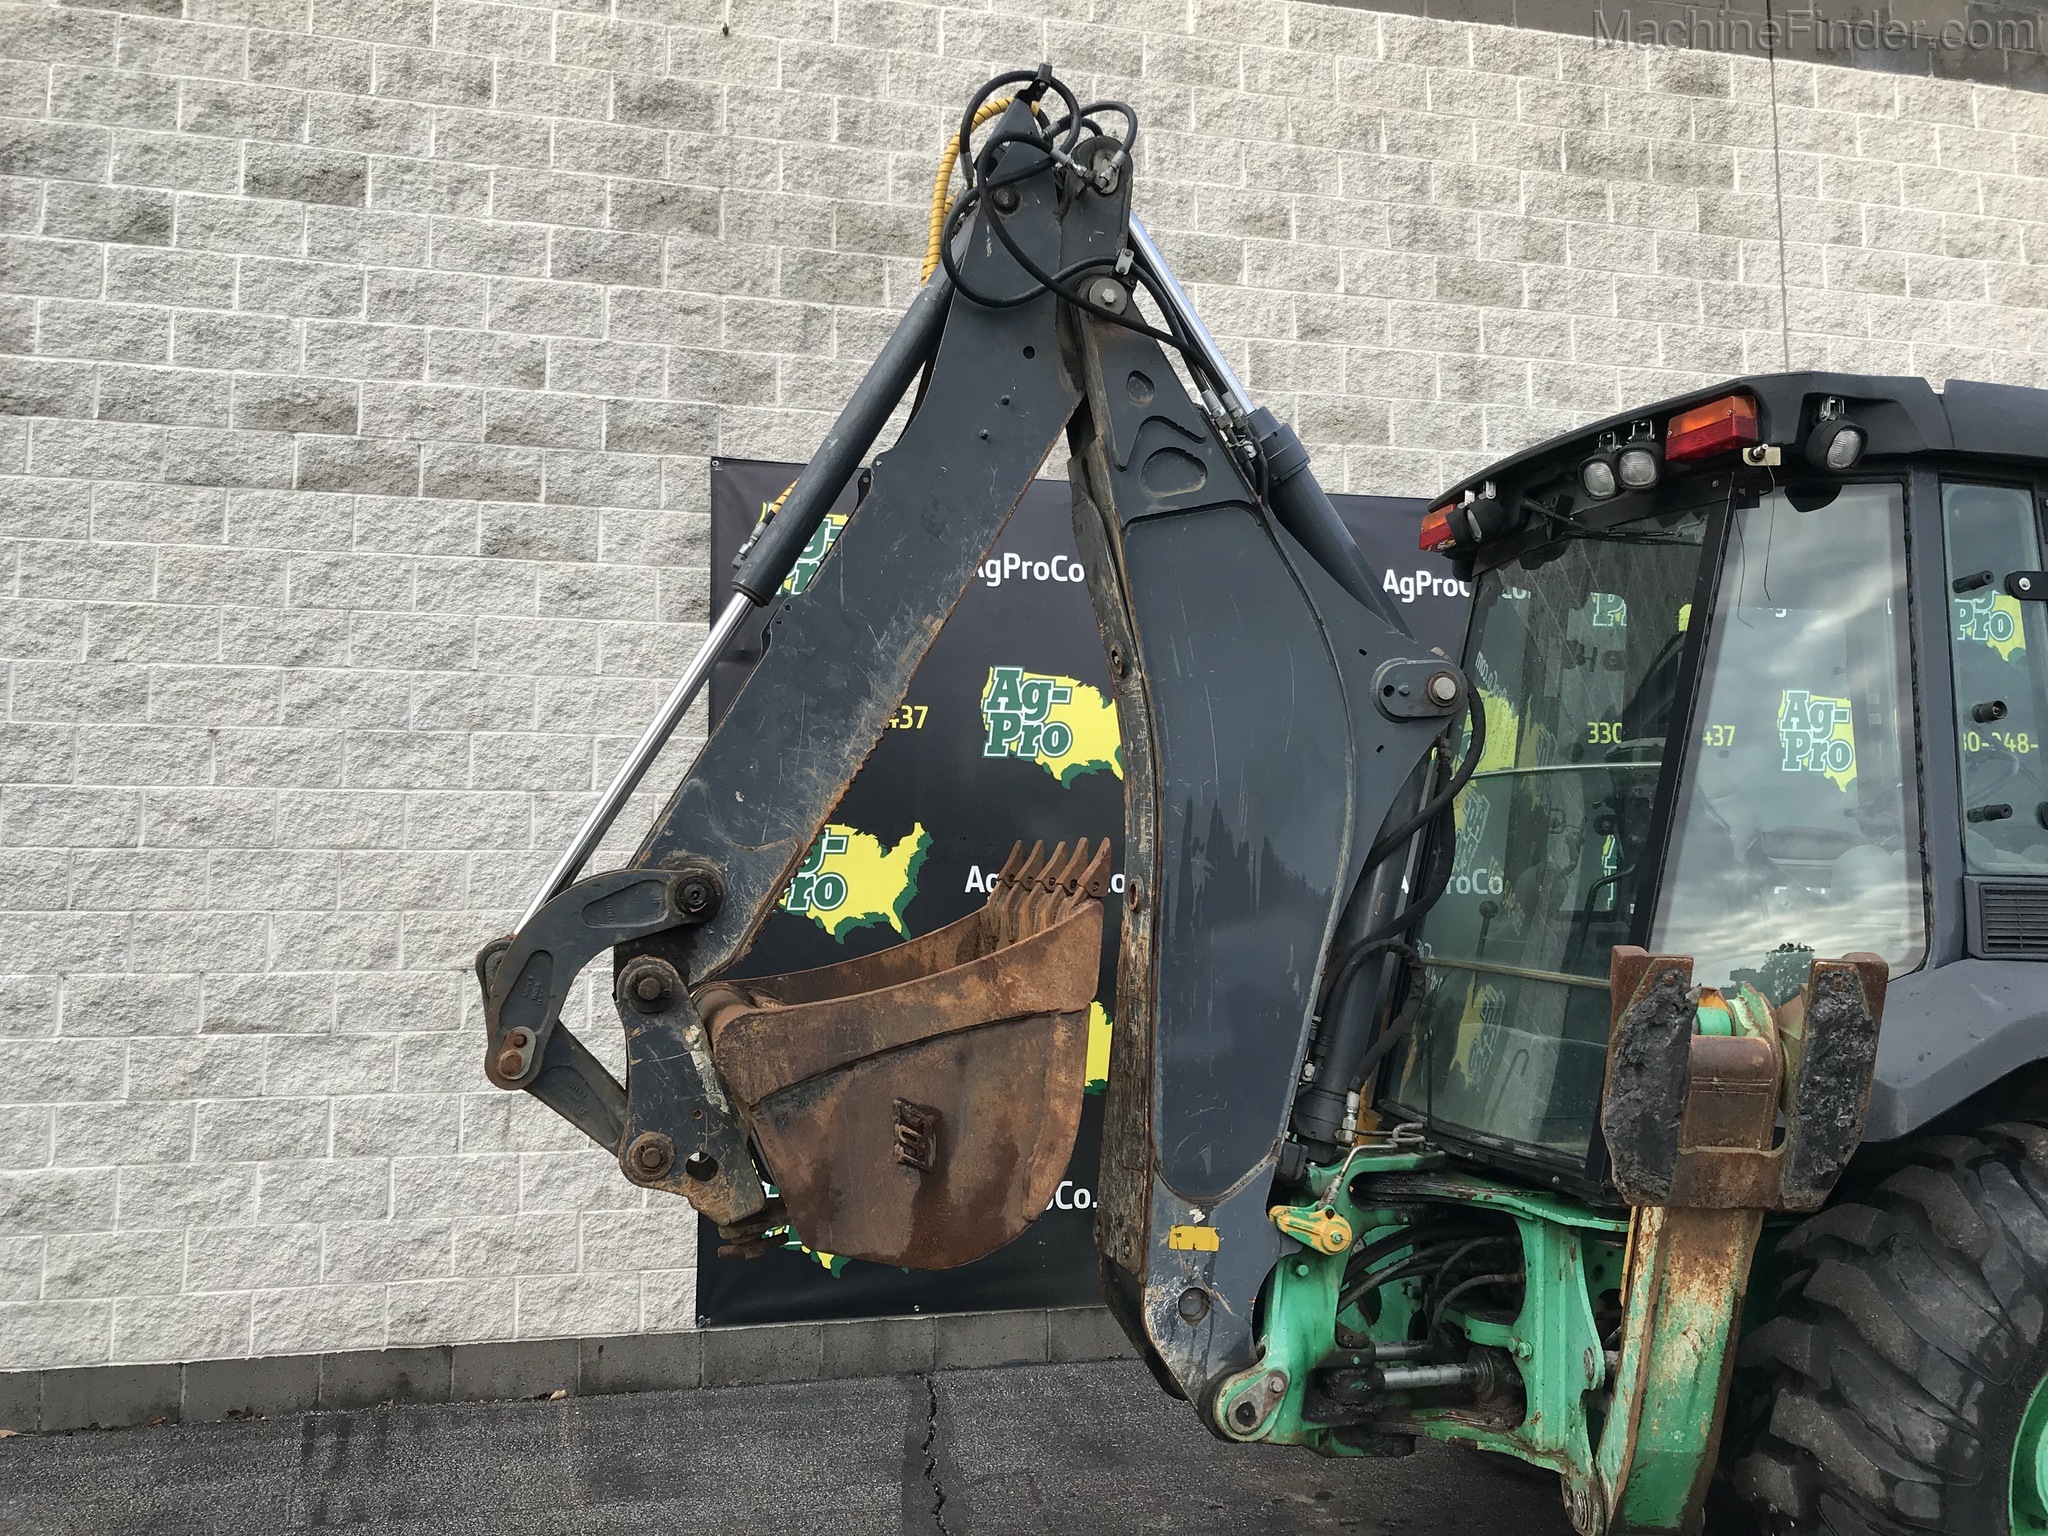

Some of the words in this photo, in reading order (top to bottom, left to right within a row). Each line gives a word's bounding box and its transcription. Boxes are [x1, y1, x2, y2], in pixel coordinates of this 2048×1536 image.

[983, 666, 1072, 723] Ag-
[1779, 690, 1850, 741] Ag-
[983, 711, 1072, 757] Pro
[1782, 730, 1853, 772] Pro
[783, 873, 847, 911] ro
[1045, 1180, 1098, 1211] Co.
